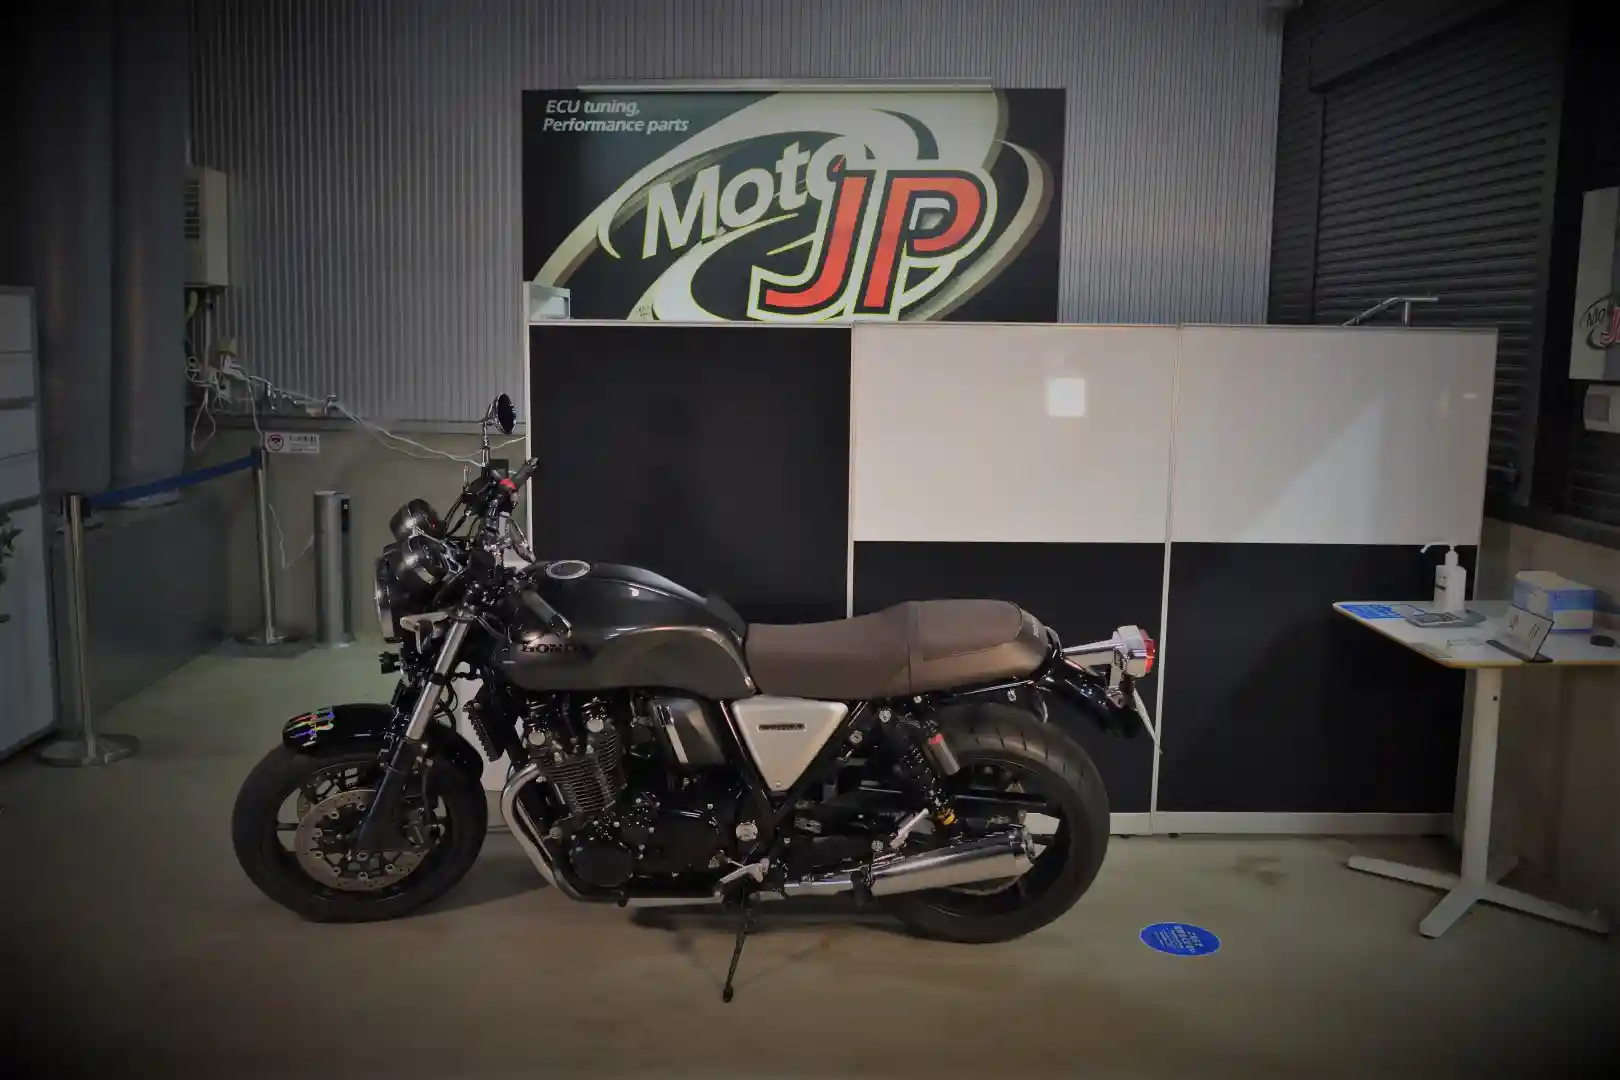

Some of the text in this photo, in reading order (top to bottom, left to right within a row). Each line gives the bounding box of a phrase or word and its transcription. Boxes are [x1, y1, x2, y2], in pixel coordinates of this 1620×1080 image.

[545, 100, 641, 117] ECU tuning,
[542, 117, 690, 135] Performance parts
[752, 166, 991, 318] JP
